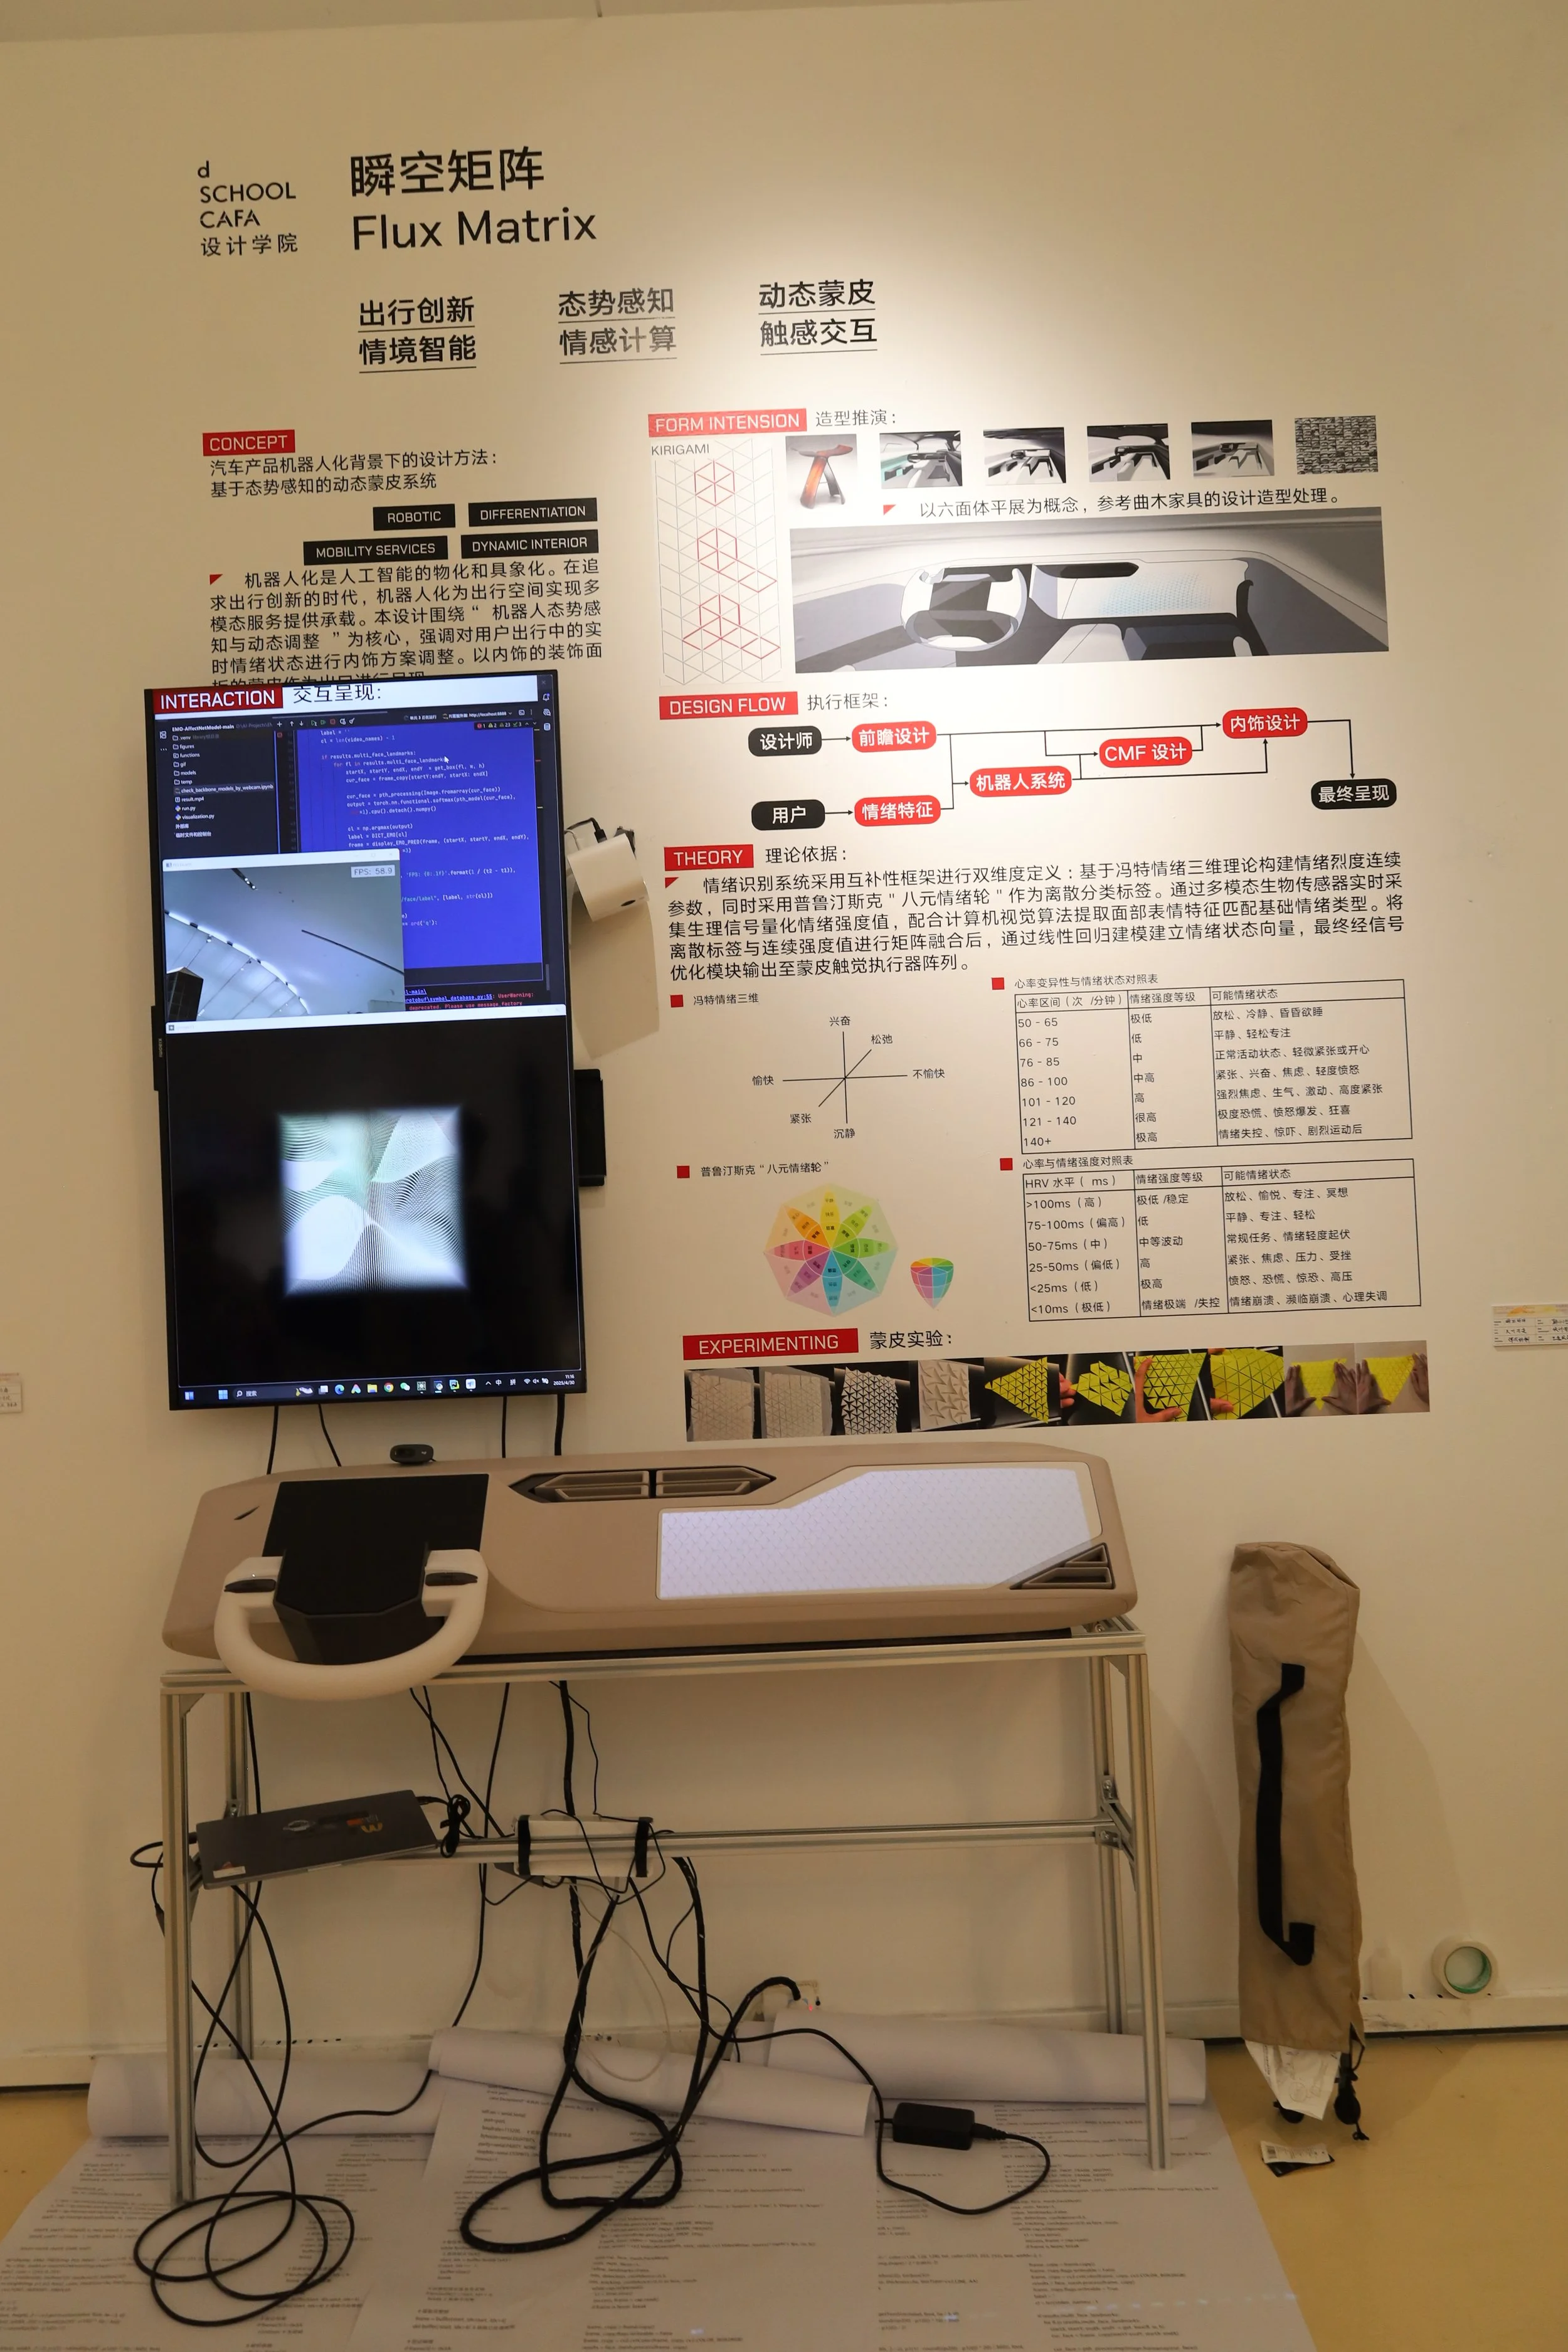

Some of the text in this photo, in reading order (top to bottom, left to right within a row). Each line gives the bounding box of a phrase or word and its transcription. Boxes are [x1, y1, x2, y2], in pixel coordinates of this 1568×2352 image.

[198, 161, 209, 178] d
[350, 146, 544, 196] 瞬空矩阵
[200, 182, 296, 203] SCHOOL
[200, 209, 260, 228] CAFA
[352, 208, 596, 250] Flux Matrix
[201, 233, 298, 257] 设计学院
[759, 278, 876, 309] 动态蒙皮
[359, 295, 474, 327] 出行创新
[558, 288, 674, 318] 态势感知
[559, 326, 677, 357] 情感计算
[760, 318, 877, 349] 触感交互
[359, 334, 476, 366] 情境智能
[655, 413, 800, 432] FORM INTENSION
[815, 410, 896, 426] 造型推演：
[209, 435, 288, 452] CONCEPT
[651, 444, 709, 456] KIRIGAMI
[211, 448, 496, 477] 汽车产品机器人化背景下的设计方法：
[211, 472, 436, 498] 基于态势感知的动态蒙皮系统
[921, 487, 1339, 519] 以六面体平展为概念，参考曲木家具的设计造型处理。
[388, 511, 441, 523] ROBOTIC
[480, 506, 586, 521] DIFFERENTIATION
[316, 542, 435, 558] MOBILITY SERVICES
[472, 536, 588, 553] DYNAMIC INTERIOR
[245, 558, 599, 588] 机器人化是人工智能的物化和具象化。在追
[211, 580, 600, 610] 求出行创新的时代，机器人化为出行空间实现多
[211, 642, 603, 674] 时情绪状态进行内饰方案调整。以内饰的装饰面
[160, 689, 275, 710] INTERACTION
[294, 684, 381, 704] 交互呈现：
[807, 692, 888, 711] 执行框架：
[670, 697, 786, 715] DESIGN FLOW
[1231, 713, 1300, 733] 内饰设计
[760, 731, 813, 751] 设计师
[859, 726, 930, 747] 前瞻设计
[1105, 742, 1187, 762] CMF 设计
[976, 771, 1066, 792] 机器人系统
[1318, 784, 1389, 804] 最终呈现
[773, 806, 806, 824] 用户
[862, 801, 934, 821] 情绪特征
[674, 850, 743, 866] THEORY
[766, 845, 846, 863] 理论依据：
[671, 954, 968, 981] 优化模块输出至蒙皮触觉执行器阵列。
[1015, 975, 1158, 988] 心率变异性与情绪状态对照表
[693, 993, 759, 1005] 冯特情绪三维
[1130, 992, 1195, 1004] 情绪强度等级
[1212, 988, 1278, 1000] 可能情绪状态
[829, 1016, 850, 1027] 兴奋
[1131, 1013, 1152, 1024] 极低
[1213, 1007, 1323, 1021] 放松、冷静、昏昏欲睡
[1018, 1018, 1058, 1027] 50 65
[871, 1034, 893, 1045] 松弛
[1019, 1037, 1059, 1047] 66 75
[1132, 1033, 1142, 1044] 低
[1214, 1027, 1291, 1041] 平静、轻松专注
[1133, 1054, 1142, 1063] 中
[1215, 1044, 1370, 1061] 正常活动状态、轻微紧张或开心
[1020, 1057, 1059, 1067] 76 85
[753, 1075, 773, 1086] 愉快
[913, 1068, 945, 1079] 不愉快
[1134, 1073, 1154, 1083] 中高
[1216, 1064, 1360, 1081] 紧张、兴奋、焦虑、轻度愤怒
[1020, 1077, 1067, 1086] 86 100
[1135, 1093, 1144, 1103] 高
[1217, 1084, 1382, 1100] 强烈焦虑、生气、激动、高度紧张
[1022, 1096, 1075, 1106] 101 120
[790, 1113, 812, 1124] 紧张
[1135, 1112, 1156, 1123] 很高
[1218, 1104, 1350, 1119] 极度恐慌、愤怒爆发、狂喜
[1022, 1116, 1076, 1126] 121 140
[834, 1128, 855, 1139] 沉静
[1136, 1132, 1157, 1143] 极高
[1218, 1123, 1362, 1139] 情绪失控、惊吓、剧烈运动后
[1024, 1136, 1051, 1146] 140+
[1023, 1155, 1133, 1168] 心率与情绪强度对照表
[1136, 1172, 1203, 1184] 情绪强度等级
[1224, 1168, 1291, 1180] 可能情绪状态
[1025, 1179, 1049, 1189] HRV
[1225, 1187, 1348, 1202] 放松、愉悦、专注、冥想
[1138, 1216, 1148, 1226] 低
[1226, 1209, 1315, 1223] 平静、专注、轻松
[1139, 1236, 1183, 1248] 中等波动
[1227, 1228, 1350, 1244] 常规任务、情绪轻度起伏
[1140, 1258, 1150, 1269] 高
[1228, 1251, 1352, 1265] 紧张、焦虑、压力、受挫
[1141, 1278, 1162, 1290] 极高
[1229, 1271, 1352, 1286] 愤怒、恐慌、惊恐、高压
[1229, 1290, 1387, 1307] 情绪崩溃、濒临崩溃、心理失调
[699, 1335, 839, 1355] EXPERIMENTING
[871, 1330, 951, 1350] 蒙皮实验：
